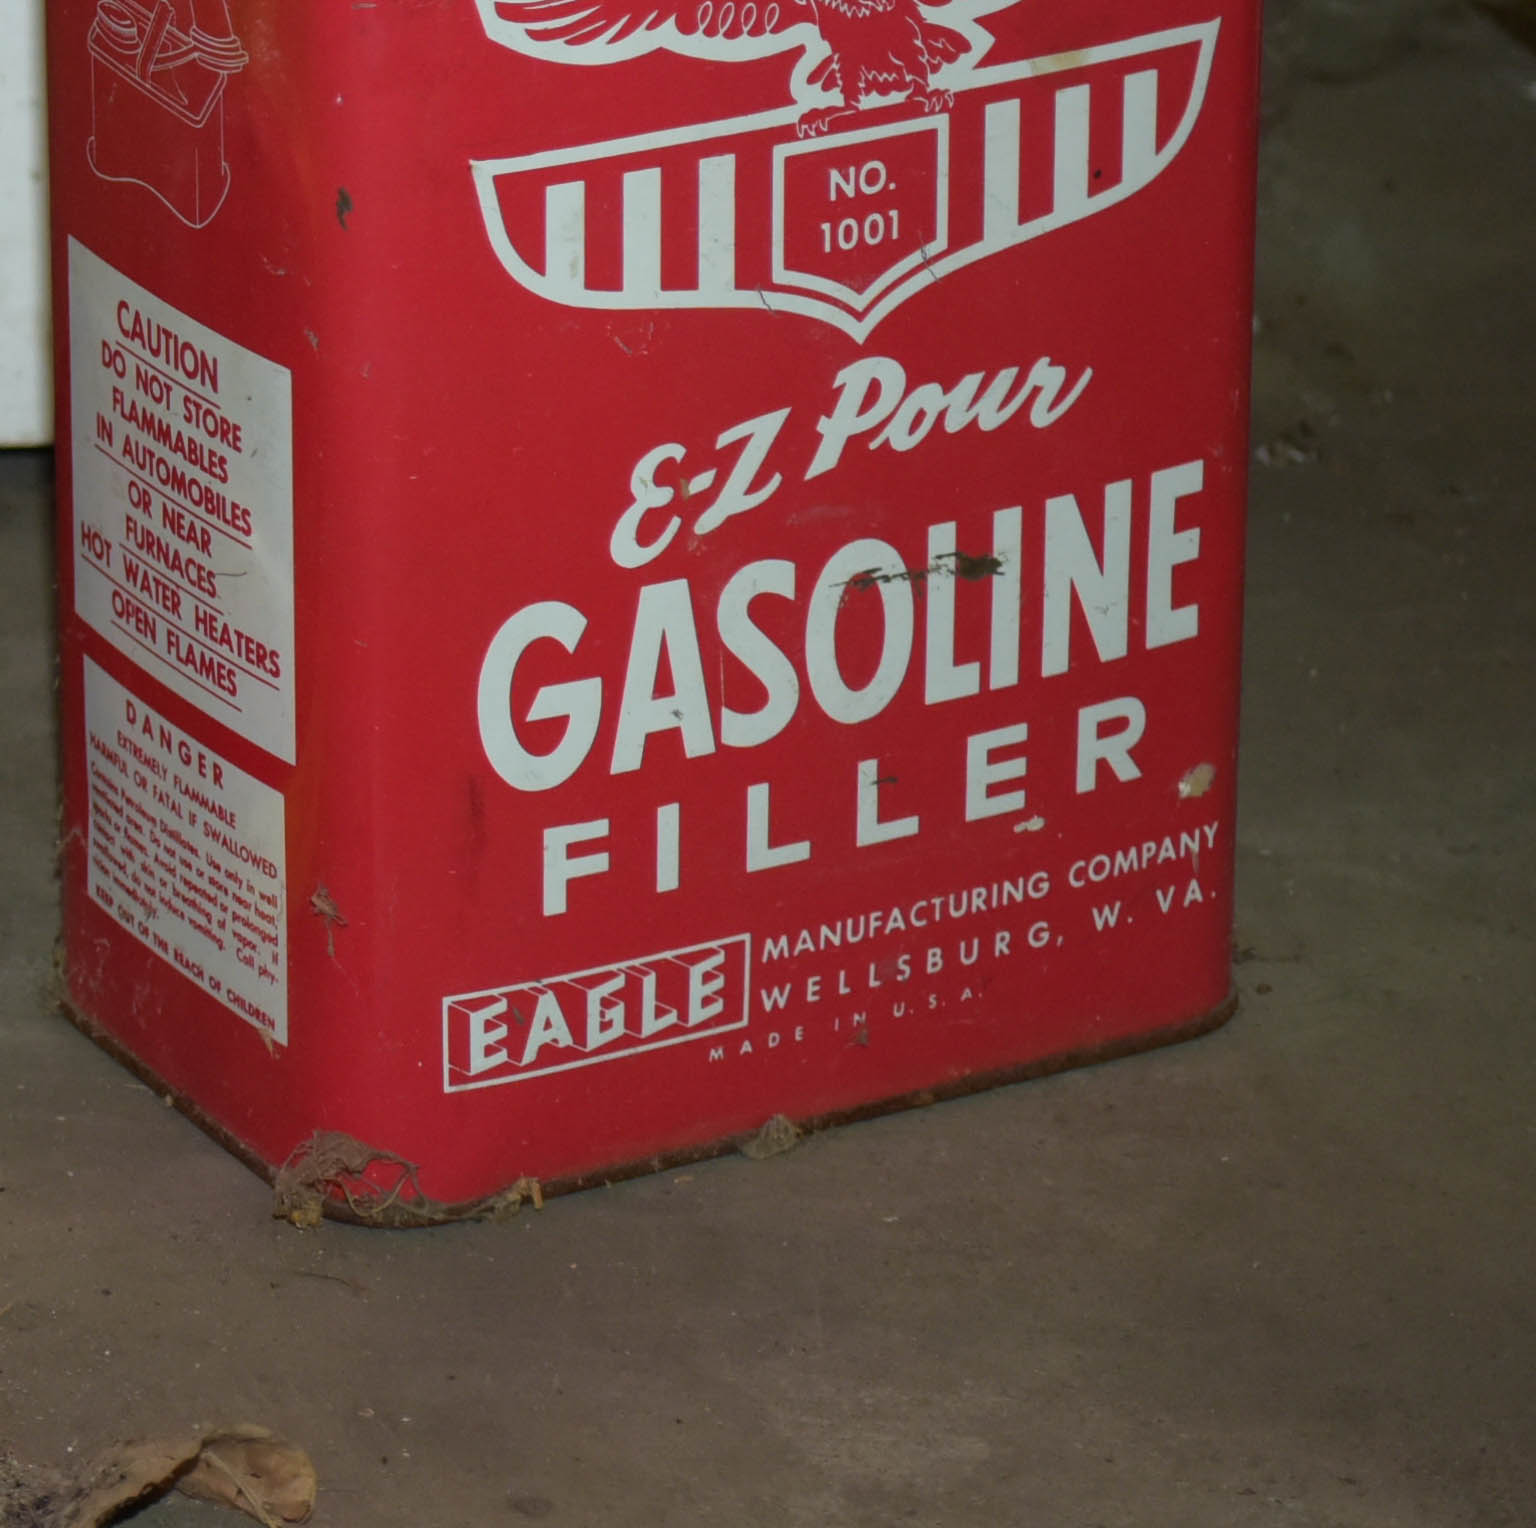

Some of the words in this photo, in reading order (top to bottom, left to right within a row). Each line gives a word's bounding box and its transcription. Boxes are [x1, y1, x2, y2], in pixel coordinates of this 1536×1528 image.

[828, 160, 897, 199] NO.
[820, 209, 901, 254] 1001
[116, 299, 219, 394] CAUTION
[101, 339, 127, 379] DO
[135, 365, 173, 412] NOT
[183, 393, 242, 454] STORE
[112, 386, 228, 484] FLAMMABLES
[96, 411, 113, 449] IN
[122, 431, 253, 537] AUTOMOBILES
[609, 408, 792, 569] E-Z
[803, 356, 1093, 480] Pour
[126, 515, 217, 599] FURNACES
[128, 480, 153, 520] OR
[162, 503, 212, 558] NEAR
[81, 520, 112, 568] HOT
[123, 554, 181, 620] WATER
[194, 603, 280, 678] HEATERS
[111, 589, 157, 646] OPEN
[166, 628, 238, 698] FLAMES
[476, 459, 1205, 792] GASOLINE
[117, 729, 168, 782] EXTREMELY
[173, 773, 237, 830] FLAMMABLE
[126, 699, 224, 790] DANGER
[134, 769, 148, 792] OR
[153, 784, 183, 820] FATAL
[188, 810, 197, 828] IF
[203, 820, 278, 879] SWALLOWED
[542, 695, 1147, 918] FILLER
[180, 873, 218, 907] repeated
[232, 910, 278, 947] prolonged
[206, 852, 221, 873] Use
[224, 868, 243, 890] only
[246, 879, 255, 895] in
[259, 891, 278, 909] well
[208, 875, 228, 897] store
[232, 891, 252, 912] near
[761, 872, 1051, 963] MANUFACTURING
[1067, 821, 1220, 889] COMPANY
[173, 947, 204, 982] REACH
[209, 976, 222, 992] OF
[227, 988, 275, 1032] CHILDREN
[236, 947, 254, 968] Call
[761, 922, 1065, 1012] WELLSBURG,
[1092, 901, 1134, 933] W.
[1157, 878, 1218, 914] VA.
[469, 946, 726, 1077] EAGLE
[709, 1026, 804, 1063] MADE
[834, 1012, 866, 1031] IN
